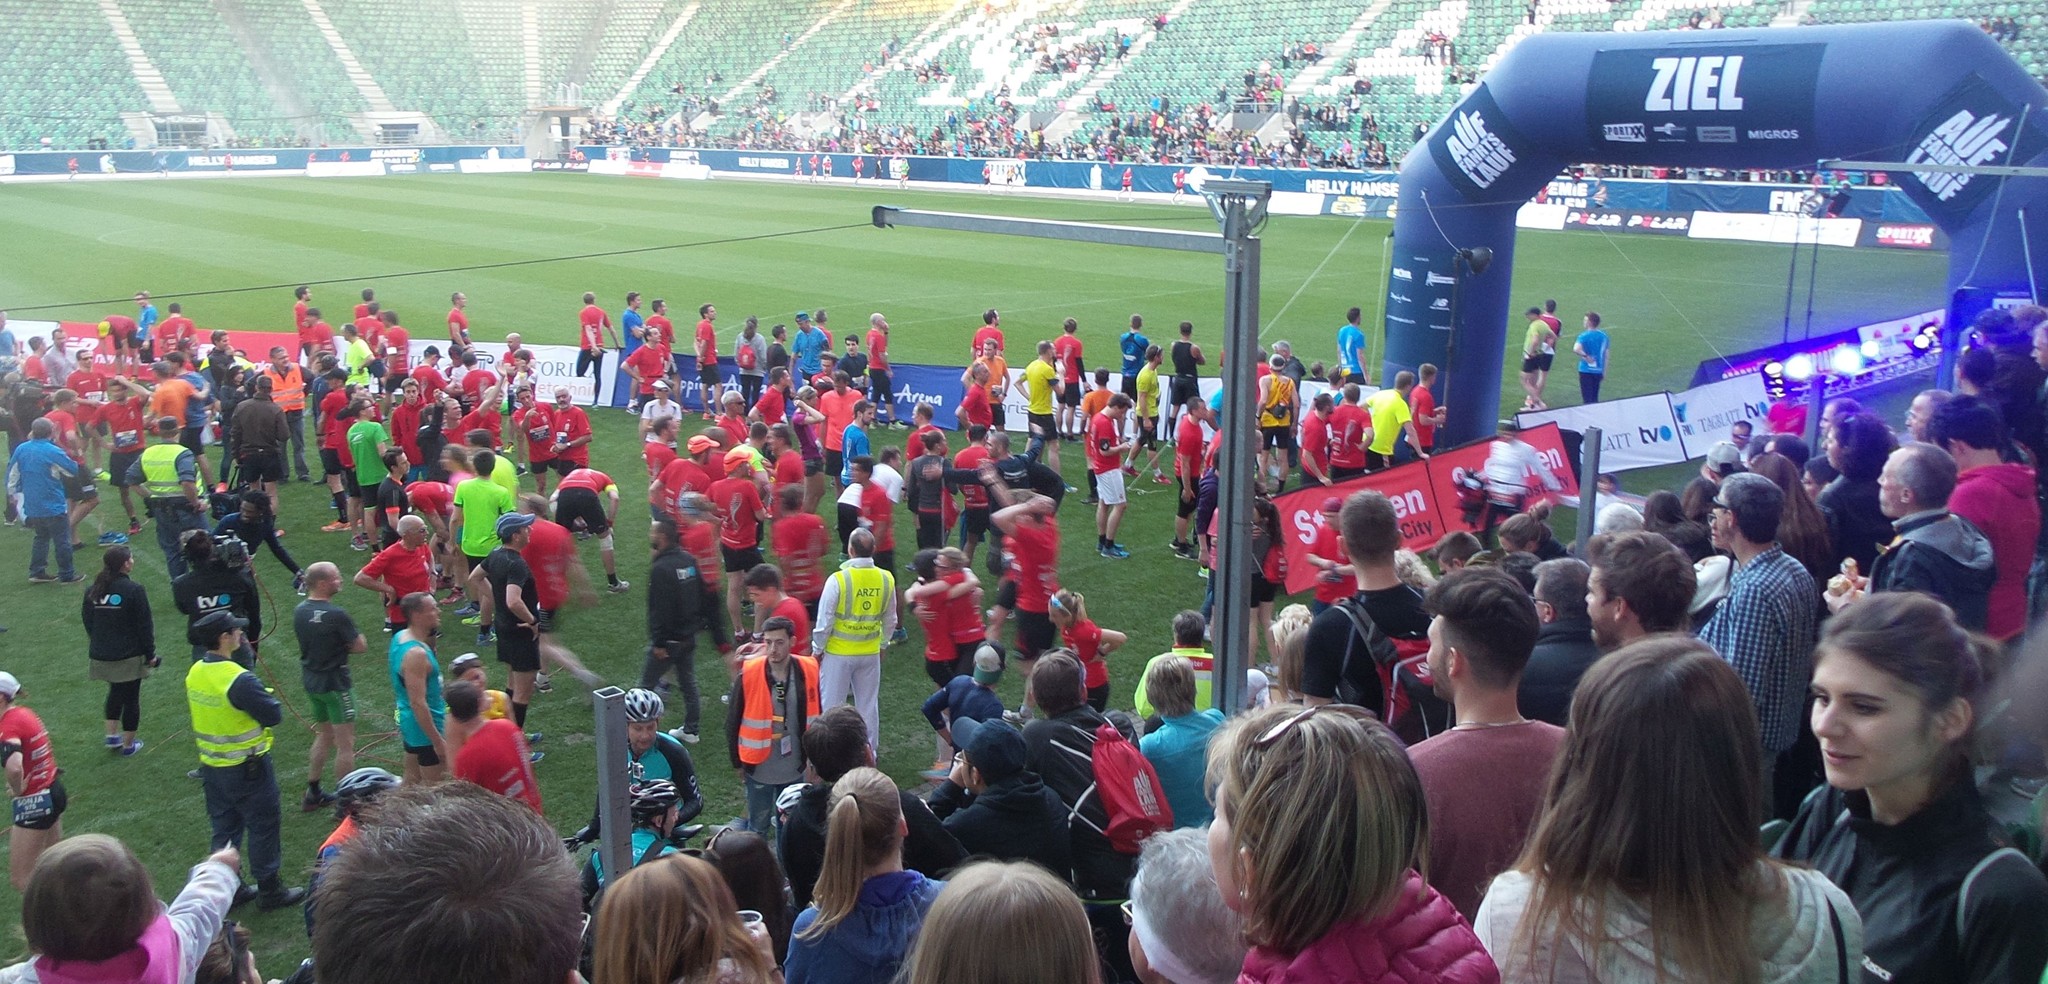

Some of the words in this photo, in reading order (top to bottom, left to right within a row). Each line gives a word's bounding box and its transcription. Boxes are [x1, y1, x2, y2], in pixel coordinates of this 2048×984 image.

[1645, 55, 1743, 111] ZIEL
[1446, 110, 1487, 162] AUF
[1748, 129, 1799, 139] MIGROS
[1932, 109, 2012, 167] AUF
[1465, 143, 1517, 189] LAUF
[1305, 179, 1349, 195] HELLY
[893, 384, 943, 406] Arena
[856, 588, 880, 598] ARZT
